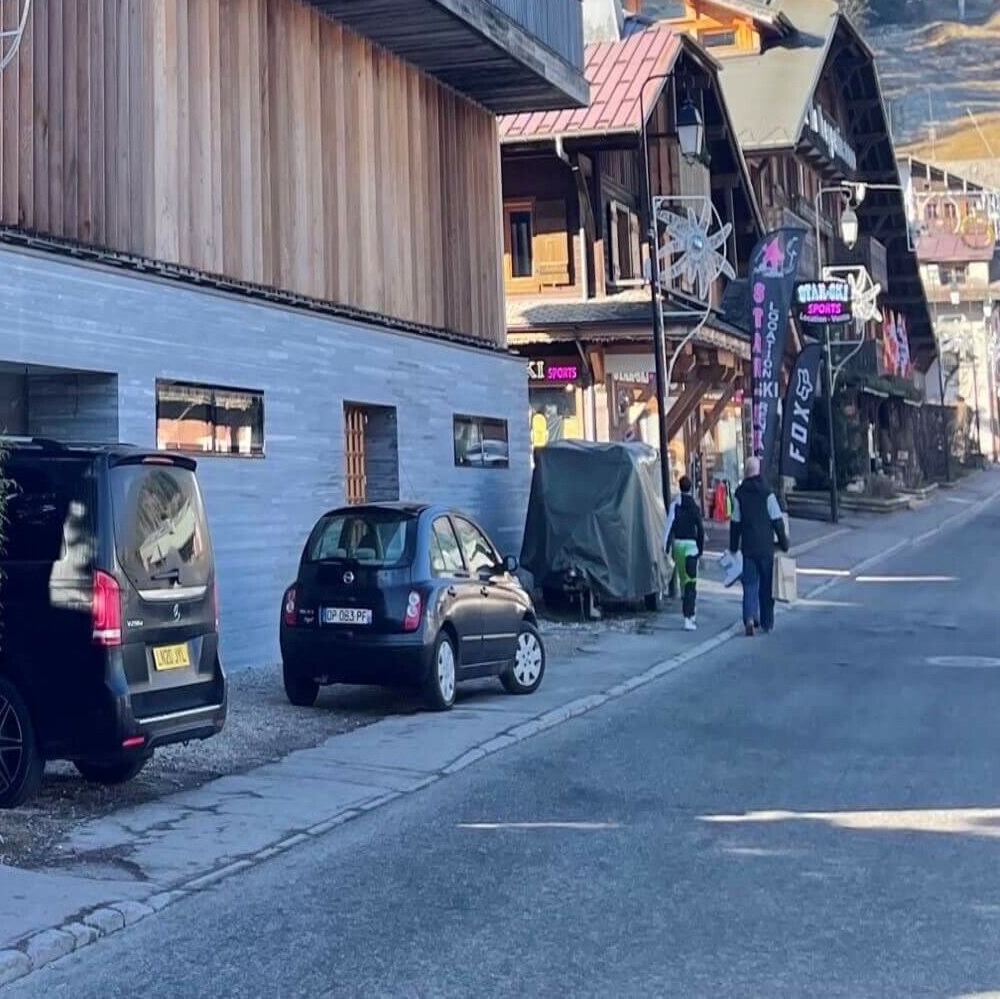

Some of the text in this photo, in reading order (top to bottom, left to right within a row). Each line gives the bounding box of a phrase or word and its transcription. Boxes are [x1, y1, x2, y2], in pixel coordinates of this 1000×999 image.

[808, 302, 841, 314] SPORTS
[547, 366, 577, 379] SPORTS
[790, 402, 811, 463] FOX
